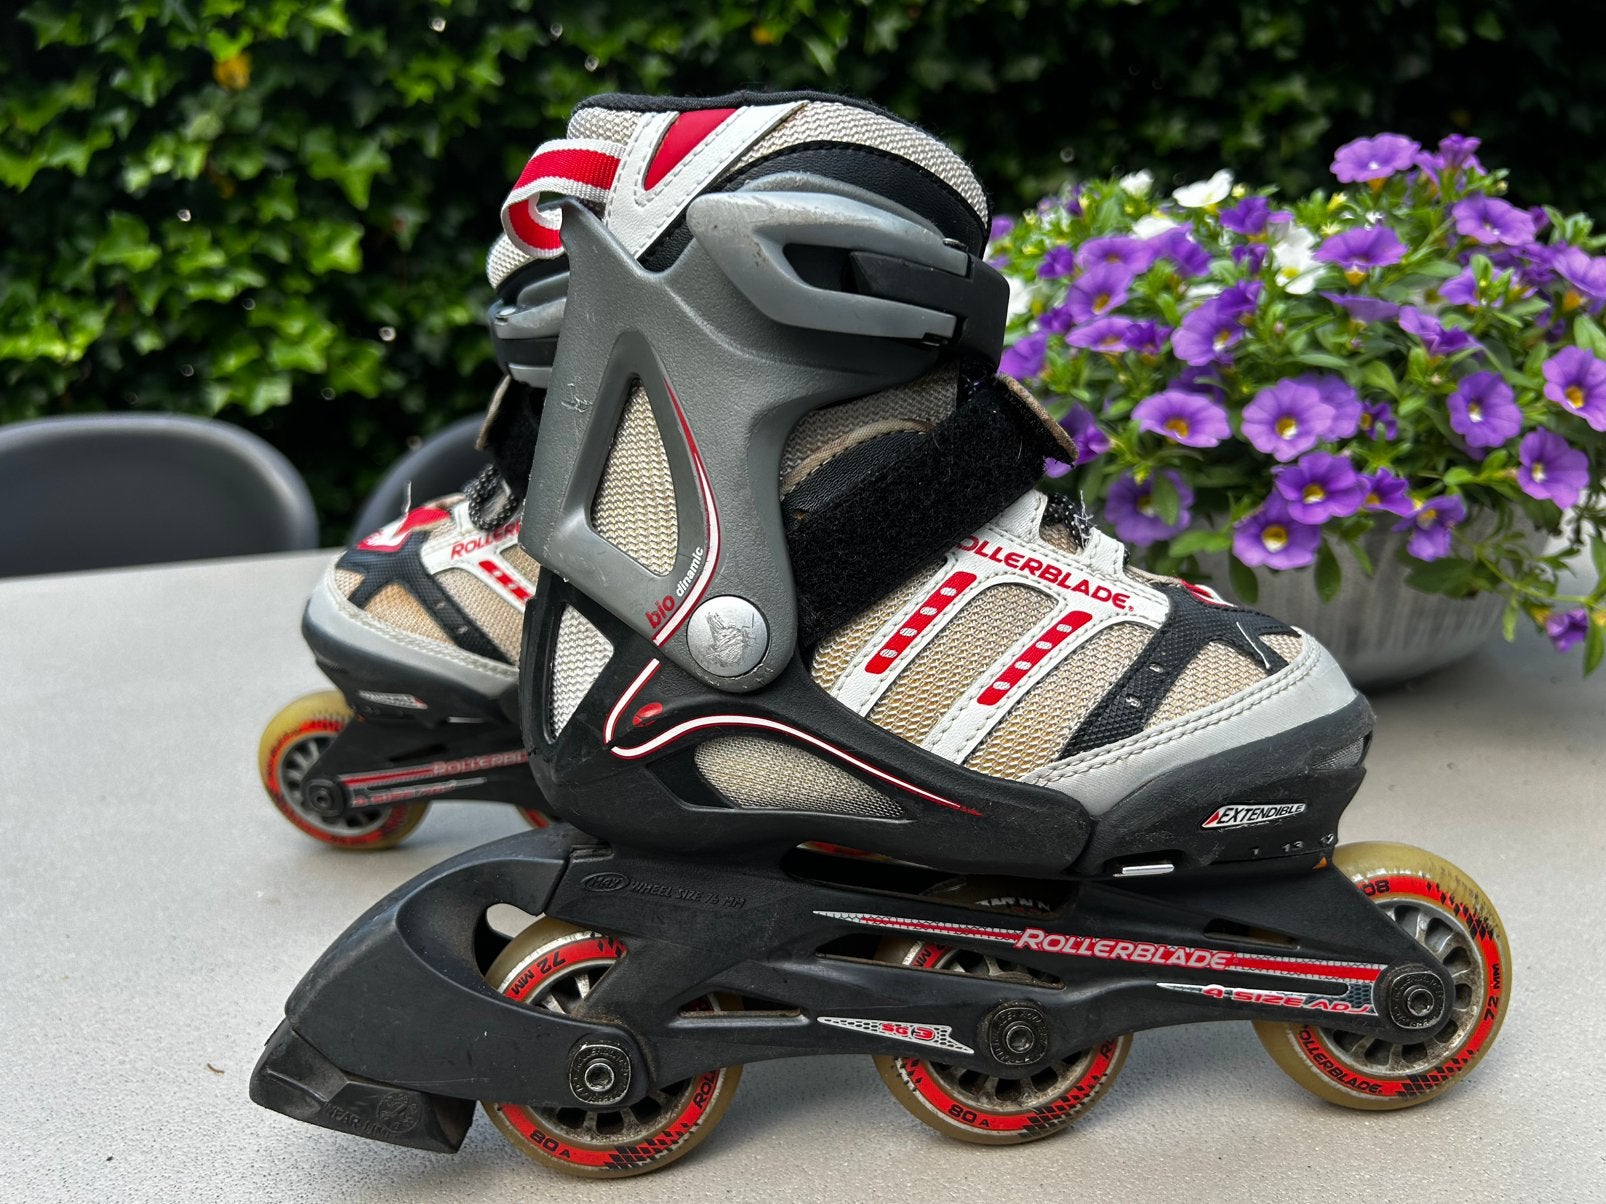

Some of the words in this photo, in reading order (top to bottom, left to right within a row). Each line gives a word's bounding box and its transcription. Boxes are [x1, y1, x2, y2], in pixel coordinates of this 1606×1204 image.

[645, 595, 675, 629] bio
[676, 546, 704, 597] dinamic
[1216, 804, 1304, 824] EXTENDIBLE
[630, 881, 672, 897] WHEEL
[676, 888, 702, 900] SIZE
[1361, 880, 1390, 896] 80
[1015, 928, 1231, 969] ROLLERBLADE
[536, 951, 566, 974] 72
[511, 969, 535, 995] MM
[1491, 963, 1500, 989] MM
[1202, 987, 1224, 998] 4
[1231, 991, 1303, 1007] SIZE
[1309, 999, 1370, 1014] ADJ
[1484, 996, 1499, 1021] 72
[948, 1104, 977, 1124] 80
[978, 1119, 990, 1128] A
[529, 1129, 562, 1154] 80
[559, 1148, 571, 1159] A
